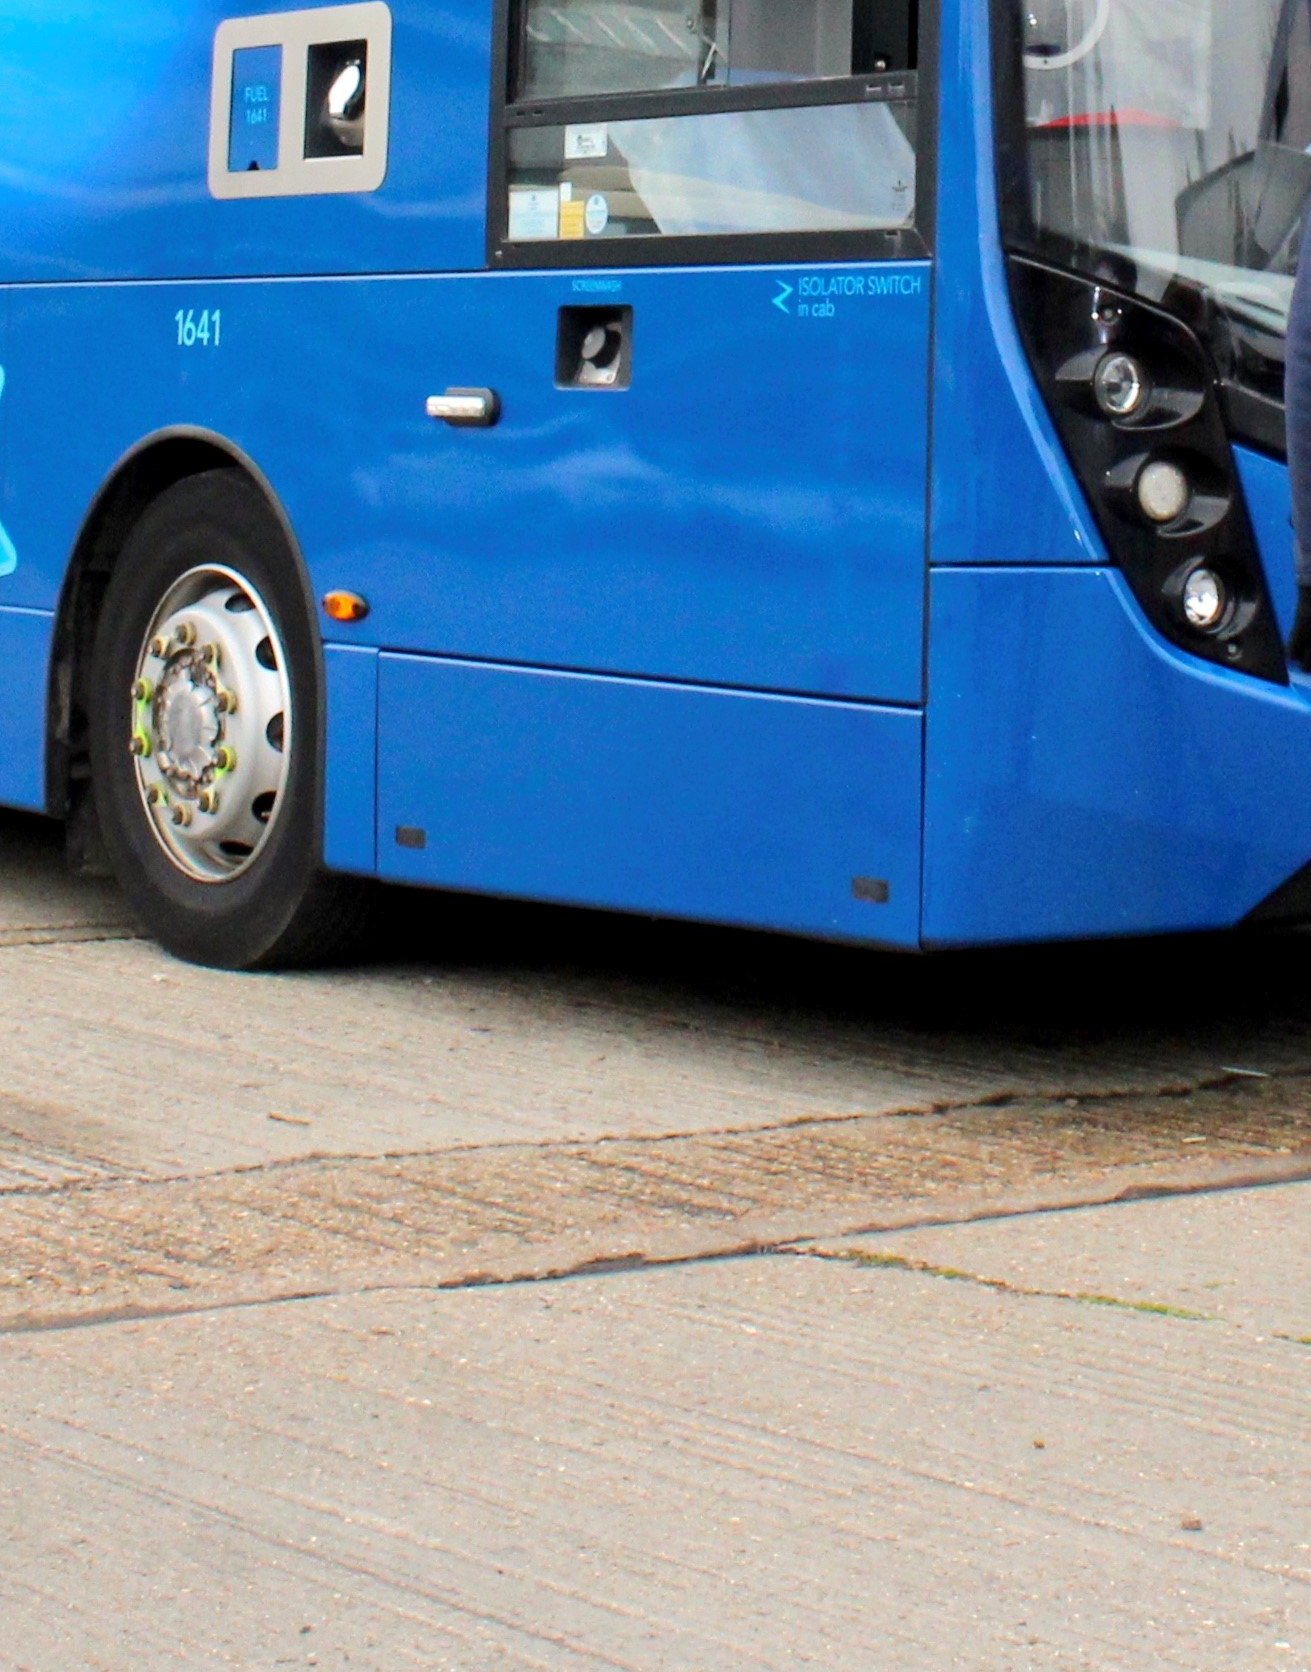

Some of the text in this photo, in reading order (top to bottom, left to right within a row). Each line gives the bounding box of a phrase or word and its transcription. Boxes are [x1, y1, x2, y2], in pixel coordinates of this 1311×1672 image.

[798, 275, 921, 295] ISOLATOR SWITCH
[798, 297, 836, 317] in cab
[174, 308, 221, 347] 1641
